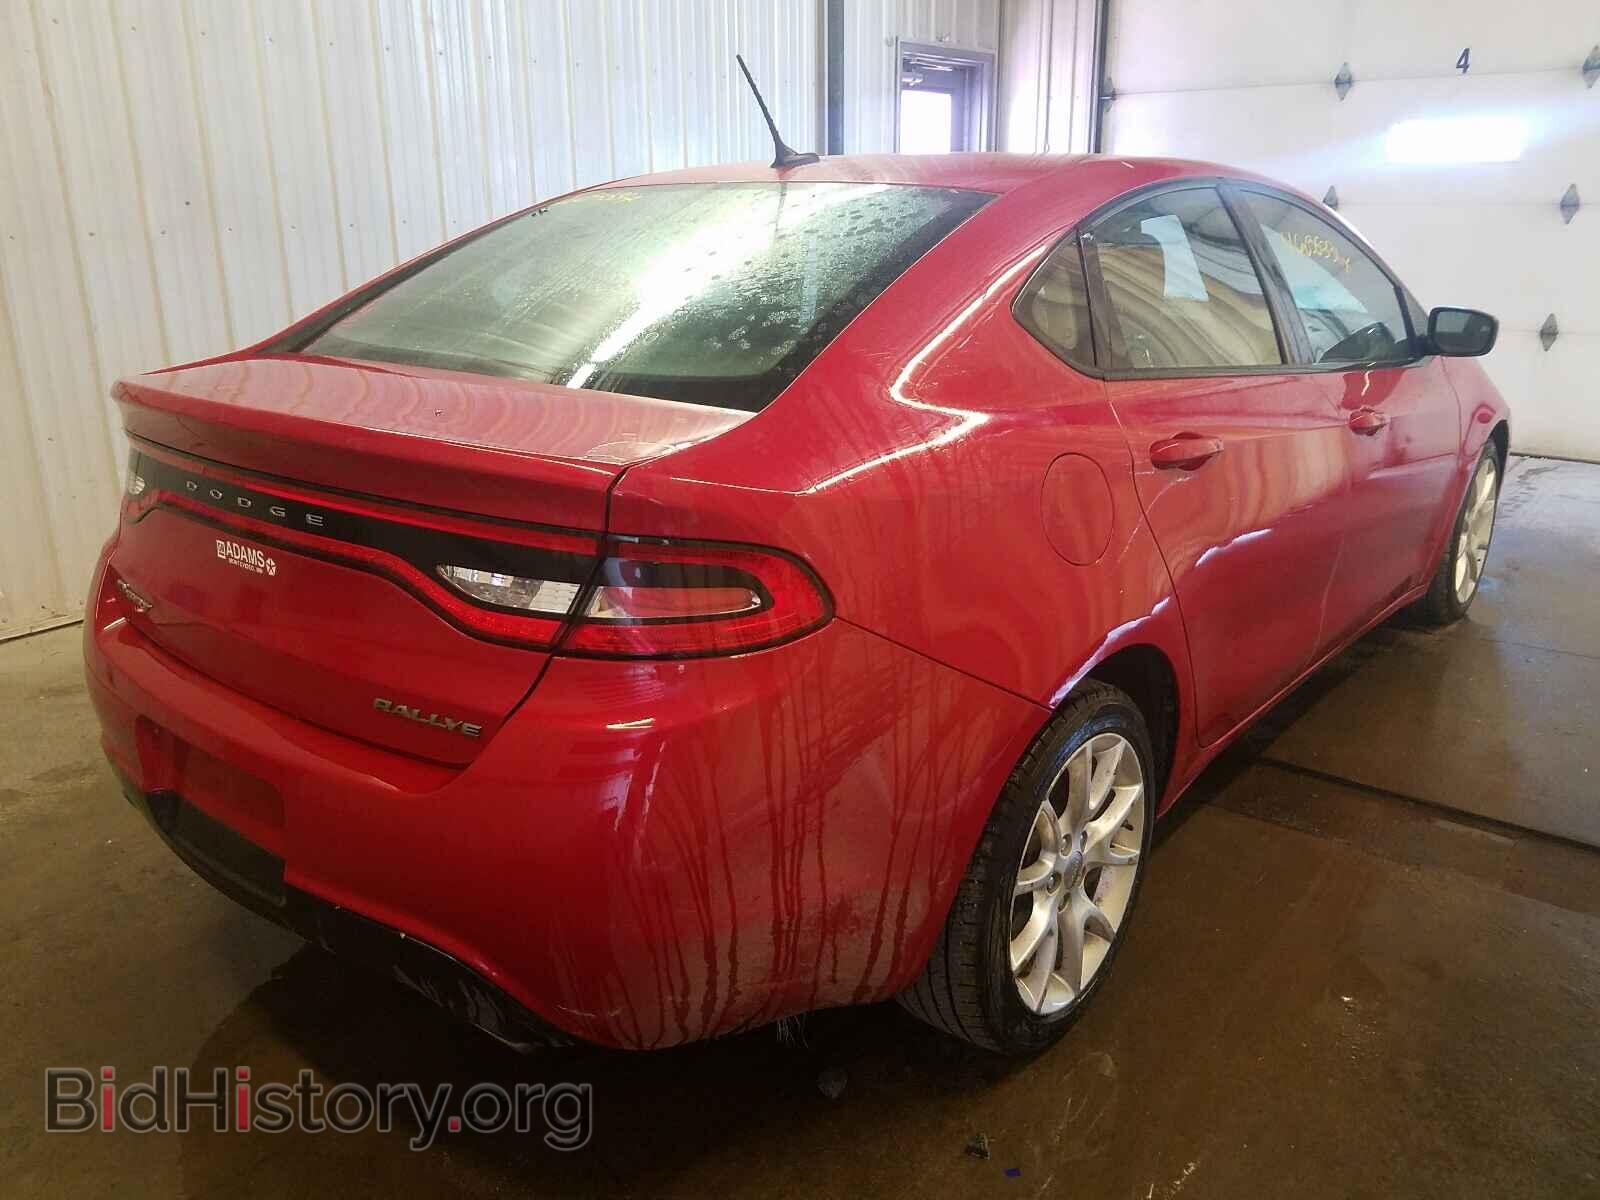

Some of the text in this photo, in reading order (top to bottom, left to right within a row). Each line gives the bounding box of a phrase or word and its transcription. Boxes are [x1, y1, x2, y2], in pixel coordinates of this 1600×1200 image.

[1456, 47, 1470, 74] 4
[186, 480, 325, 527] DODGE
[226, 541, 265, 568] ADAMS
[374, 697, 482, 737] RALLYE
